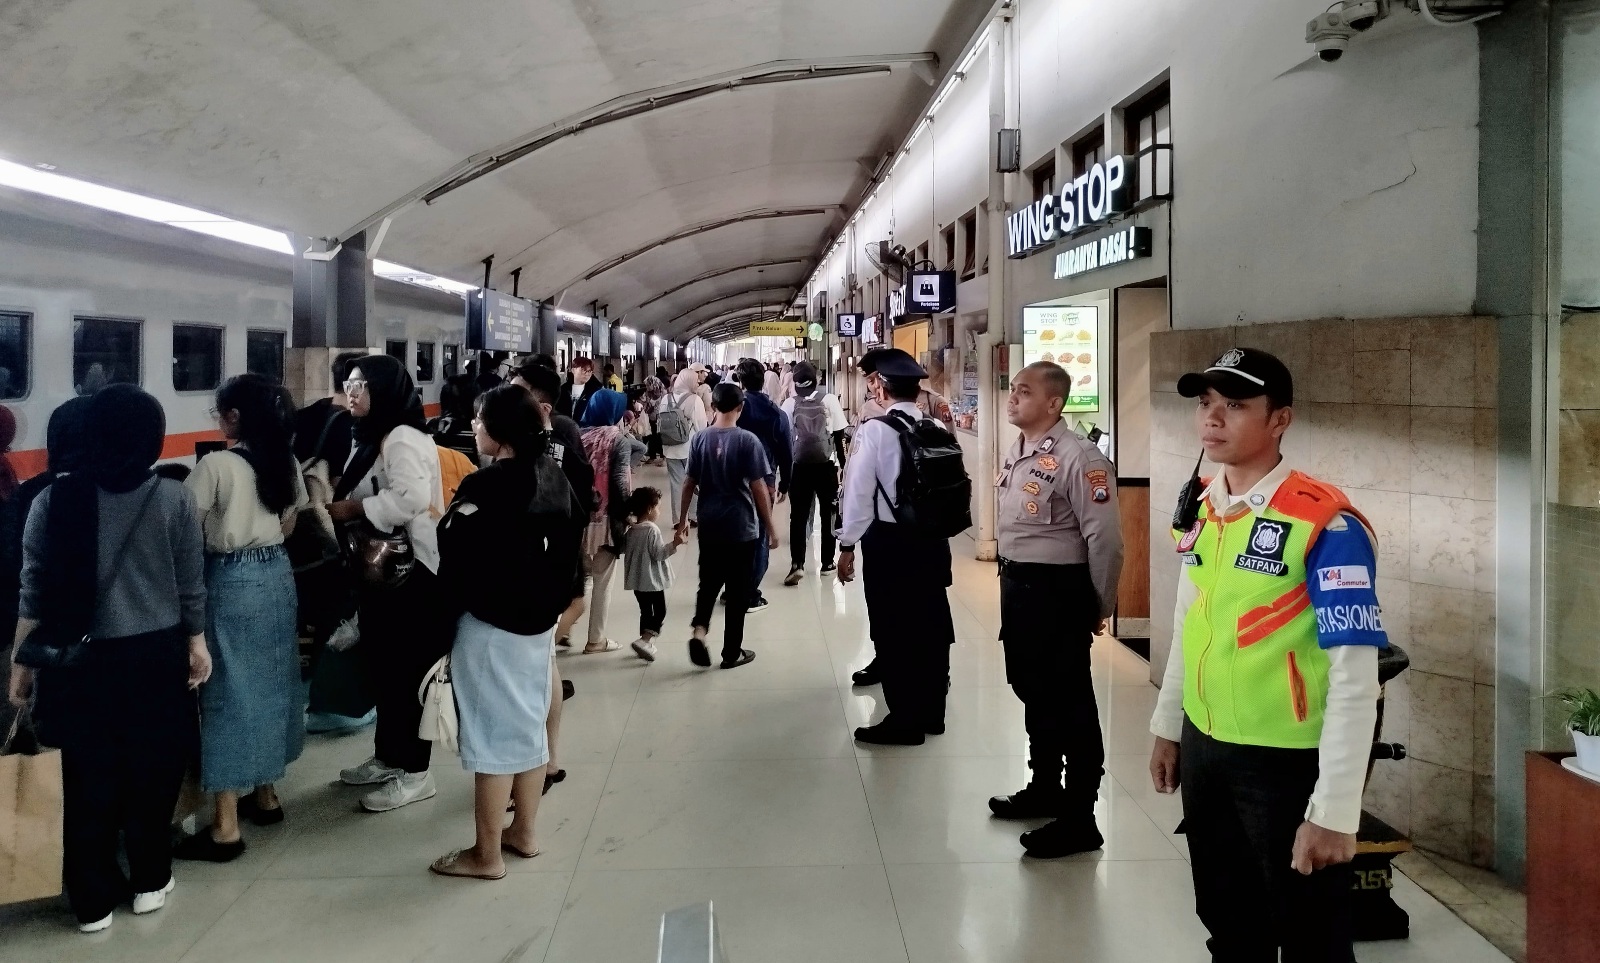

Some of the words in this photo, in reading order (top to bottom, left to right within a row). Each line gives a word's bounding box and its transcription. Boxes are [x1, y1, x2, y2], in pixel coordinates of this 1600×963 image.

[1007, 194, 1054, 255] WING
[1061, 154, 1124, 232] STOP
[1054, 241, 1098, 280] JUARANYA
[1099, 230, 1127, 266] RASA
[1029, 468, 1055, 484] POLRI
[1238, 556, 1280, 574] SATPAM
